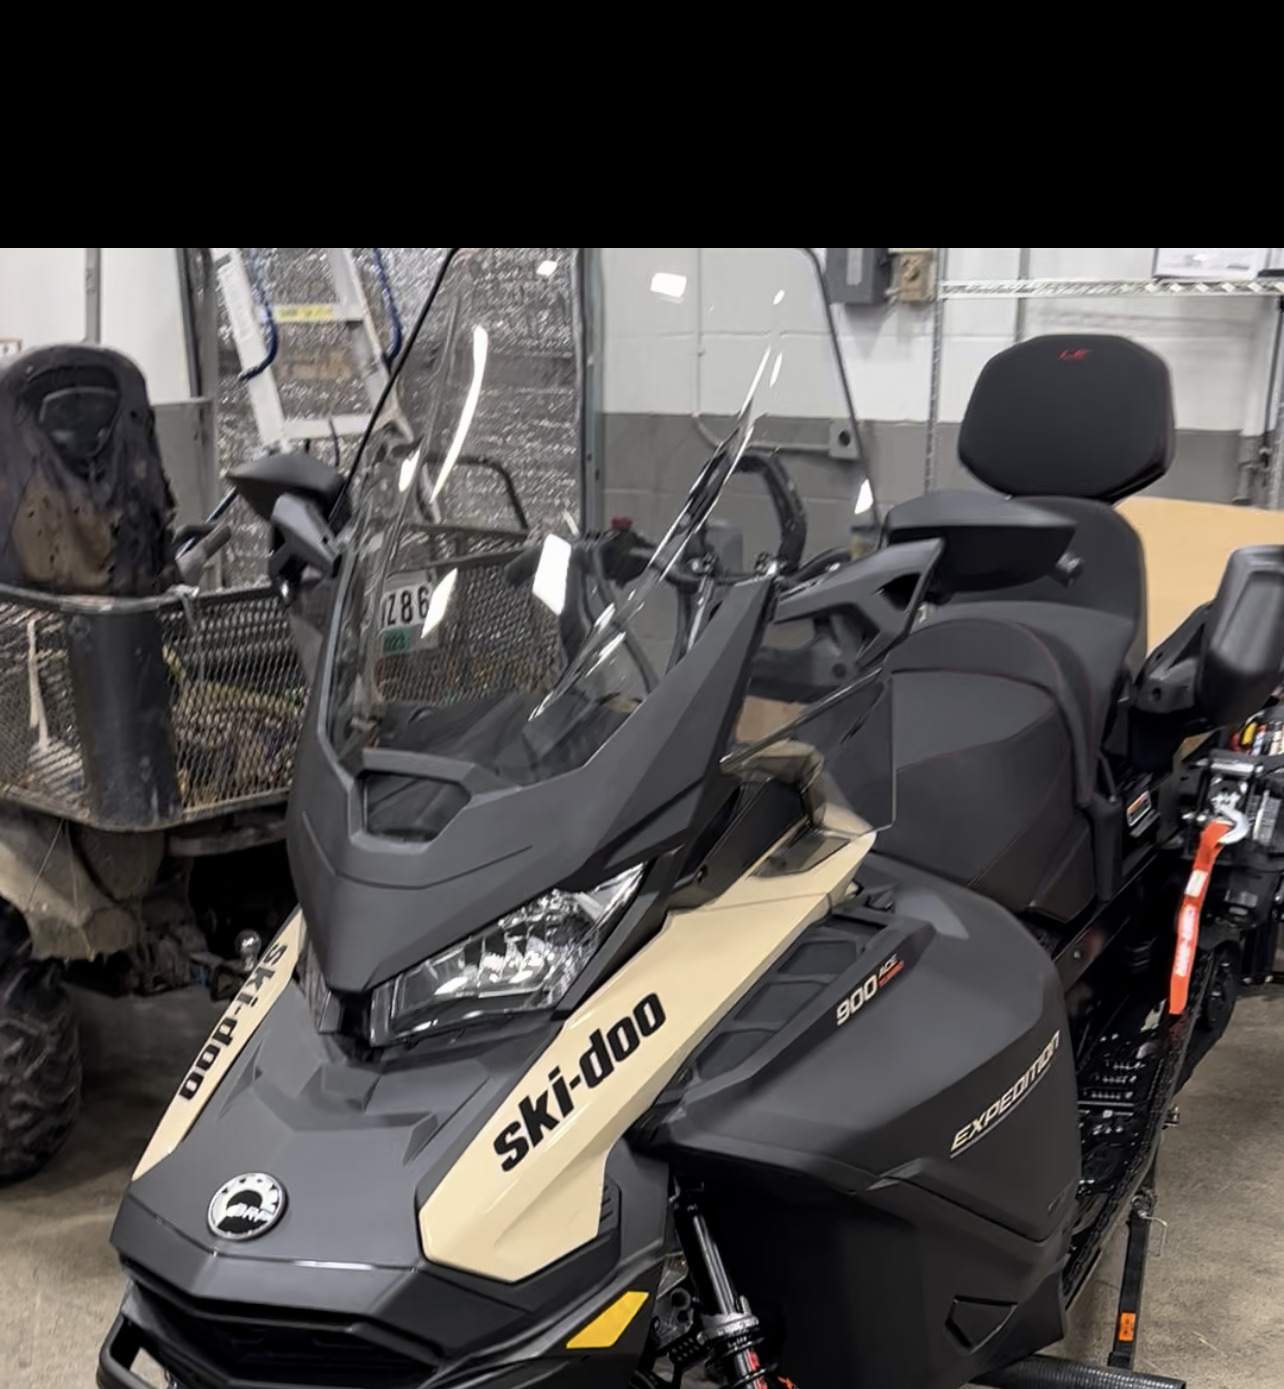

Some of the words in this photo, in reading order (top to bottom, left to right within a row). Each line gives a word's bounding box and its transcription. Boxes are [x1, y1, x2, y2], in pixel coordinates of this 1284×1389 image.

[178, 942, 289, 1101] ski-doo
[836, 974, 878, 1026] 900
[493, 992, 667, 1172] ski-doo
[950, 1029, 1061, 1152] EXPEDITION
